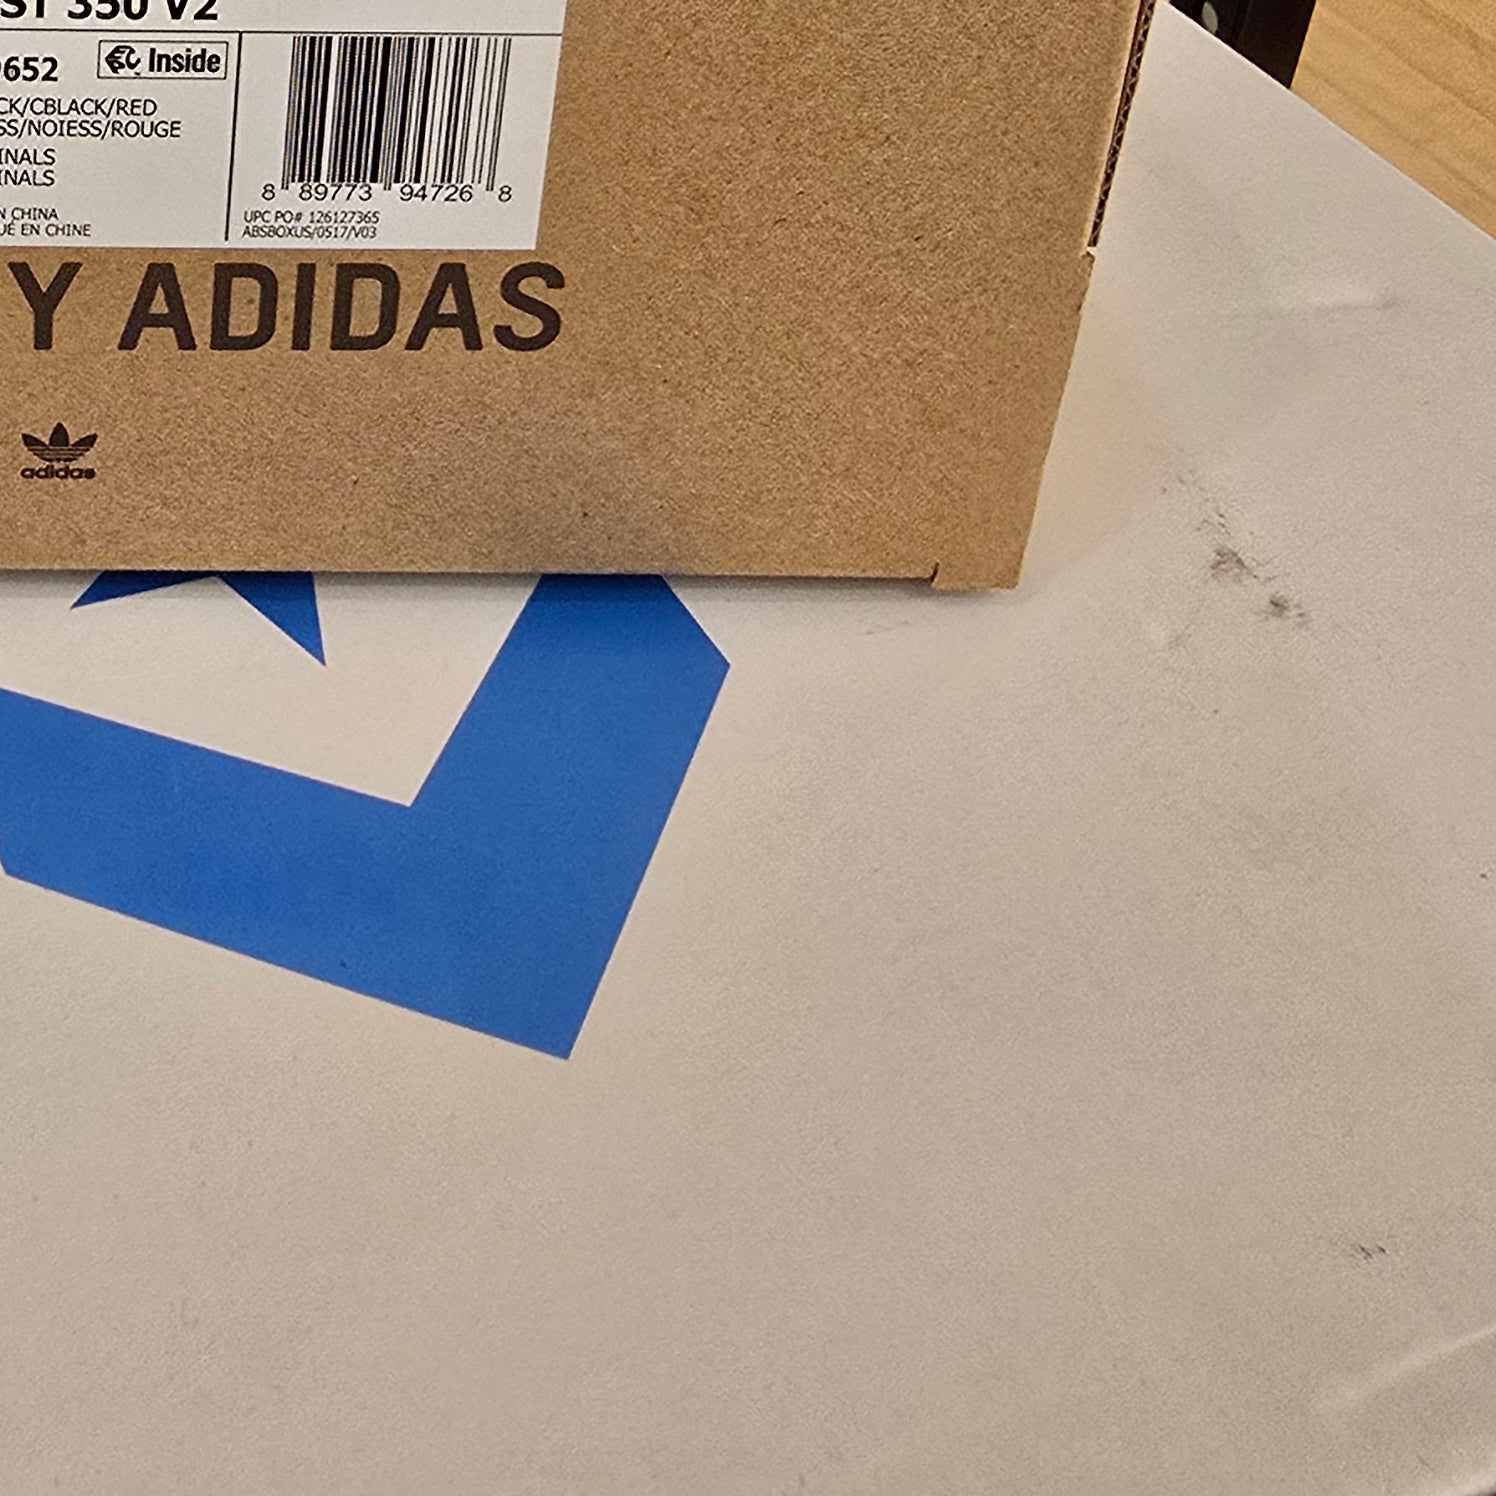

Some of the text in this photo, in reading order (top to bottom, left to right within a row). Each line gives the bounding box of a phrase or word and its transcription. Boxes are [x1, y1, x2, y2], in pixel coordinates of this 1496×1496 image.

[148, 47, 222, 74] Inside
[261, 183, 513, 204] 8 89773 94726 8
[10, 207, 60, 222] CHINA
[243, 210, 381, 225] UPC PO# 126127365
[20, 223, 40, 237] EN
[45, 223, 92, 238] CHINE
[117, 261, 567, 353] ADIDAS
[20, 464, 96, 479] adidas
